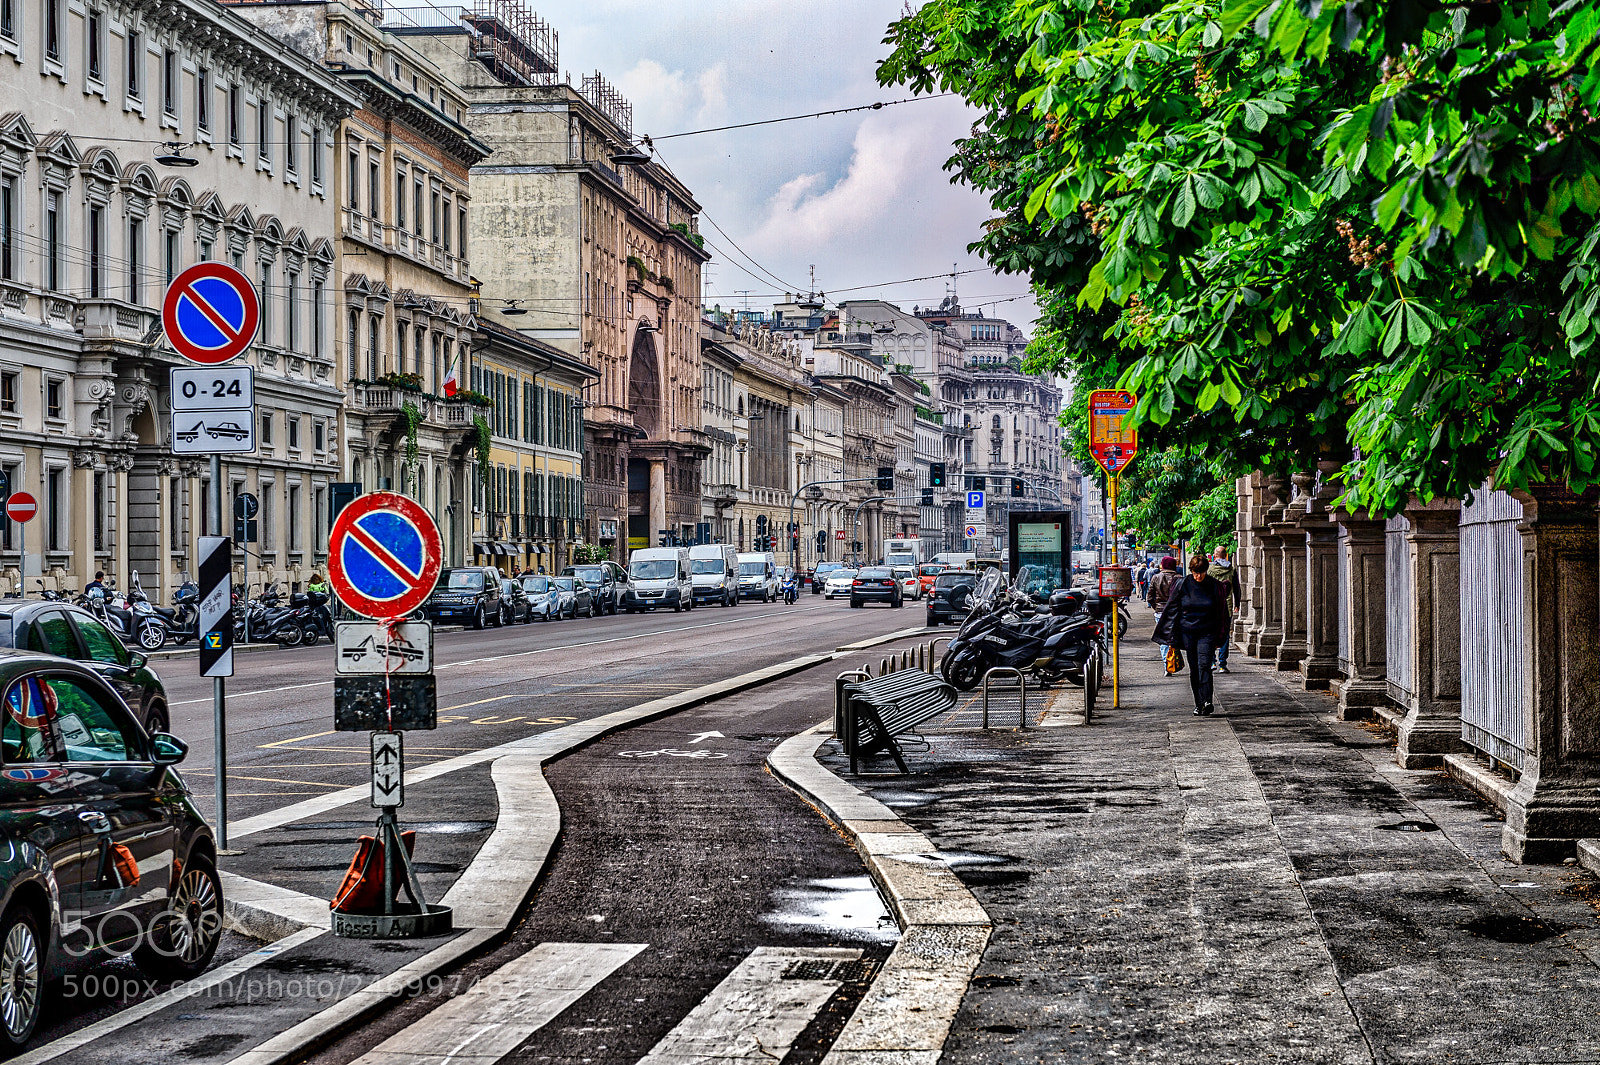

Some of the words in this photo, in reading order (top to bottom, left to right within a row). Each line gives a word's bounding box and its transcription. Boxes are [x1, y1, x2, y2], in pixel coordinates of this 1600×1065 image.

[182, 380, 197, 398] 0
[212, 379, 242, 398] 24
[971, 494, 980, 506] P
